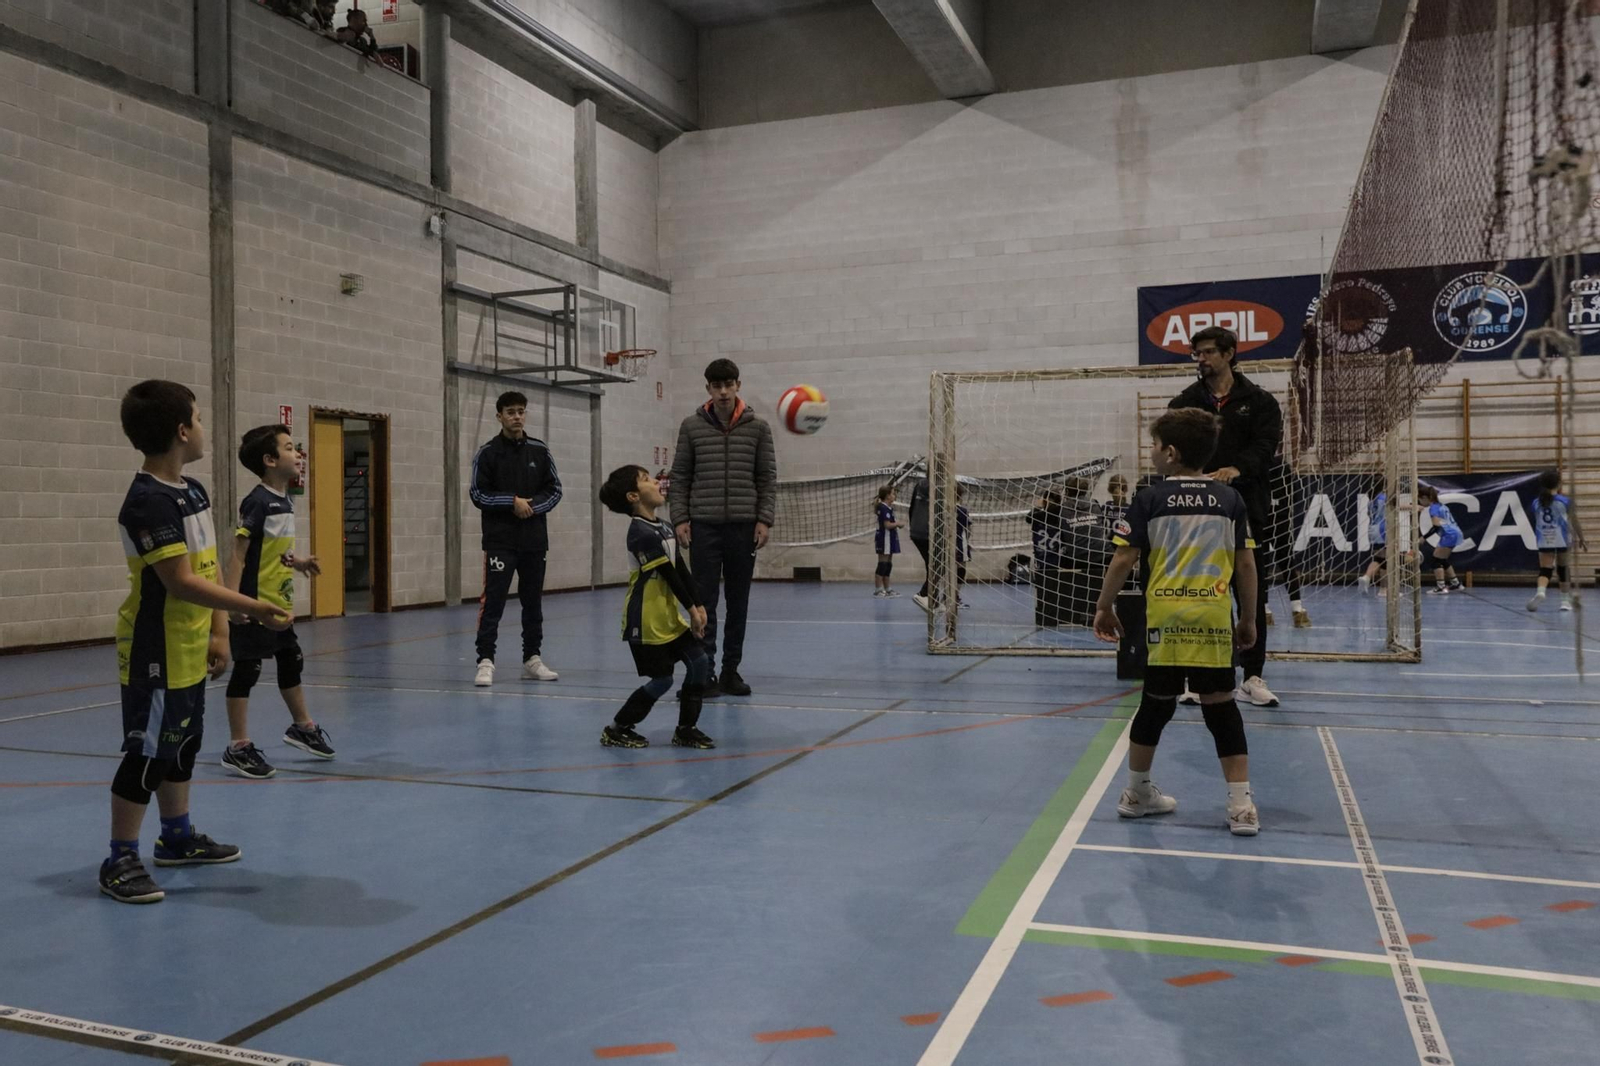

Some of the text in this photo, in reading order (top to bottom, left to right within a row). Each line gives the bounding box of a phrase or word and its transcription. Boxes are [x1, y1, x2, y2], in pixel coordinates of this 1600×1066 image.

[1440, 274, 1521, 307] CLUB VOEIBOL
[1450, 323, 1510, 336] OURENSE
[1466, 338, 1496, 349] 1989
[1167, 494, 1221, 507] SARA D.
[1542, 507, 1553, 523] 8
[1165, 517, 1222, 577] 12
[1155, 585, 1217, 598] codisoil
[1164, 626, 1204, 634] CLÍNICA
[20, 1012, 46, 1021] CLUB
[159, 1038, 284, 1064] CLUB VOLEIBOL OURENSE
